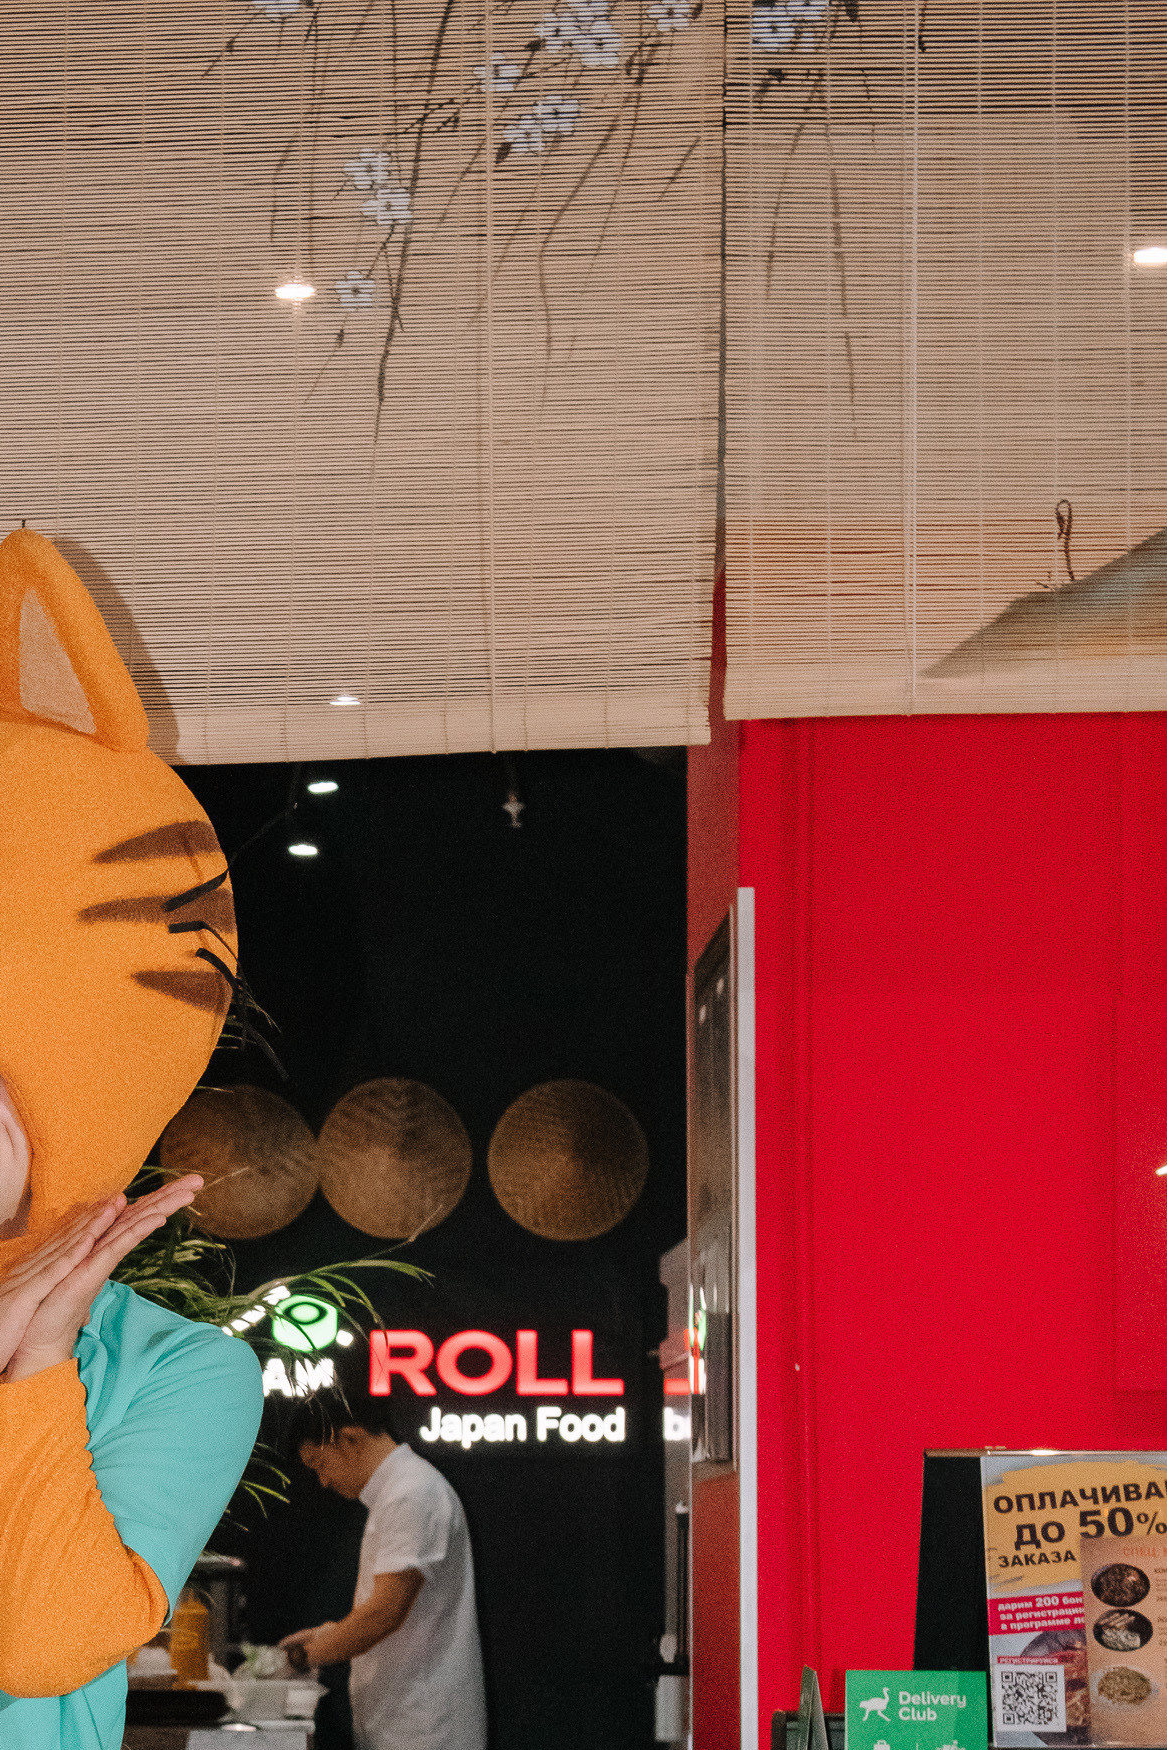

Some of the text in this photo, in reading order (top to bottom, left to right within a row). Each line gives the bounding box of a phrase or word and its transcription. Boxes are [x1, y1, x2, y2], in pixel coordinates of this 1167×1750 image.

[369, 1329, 624, 1396] ROLL
[420, 1407, 526, 1448] Japan
[536, 1406, 625, 1442] Food
[993, 1480, 1167, 1514] ОПЛАЧИВА
[1014, 1507, 1167, 1551] ДО 50%
[998, 1550, 1076, 1567] ЗАКАЗА
[998, 1602, 1032, 1612] дарим
[1035, 1596, 1059, 1607] 200
[1010, 1617, 1071, 1630] программе
[898, 1691, 966, 1708] Delivery
[898, 1707, 937, 1721] Club
